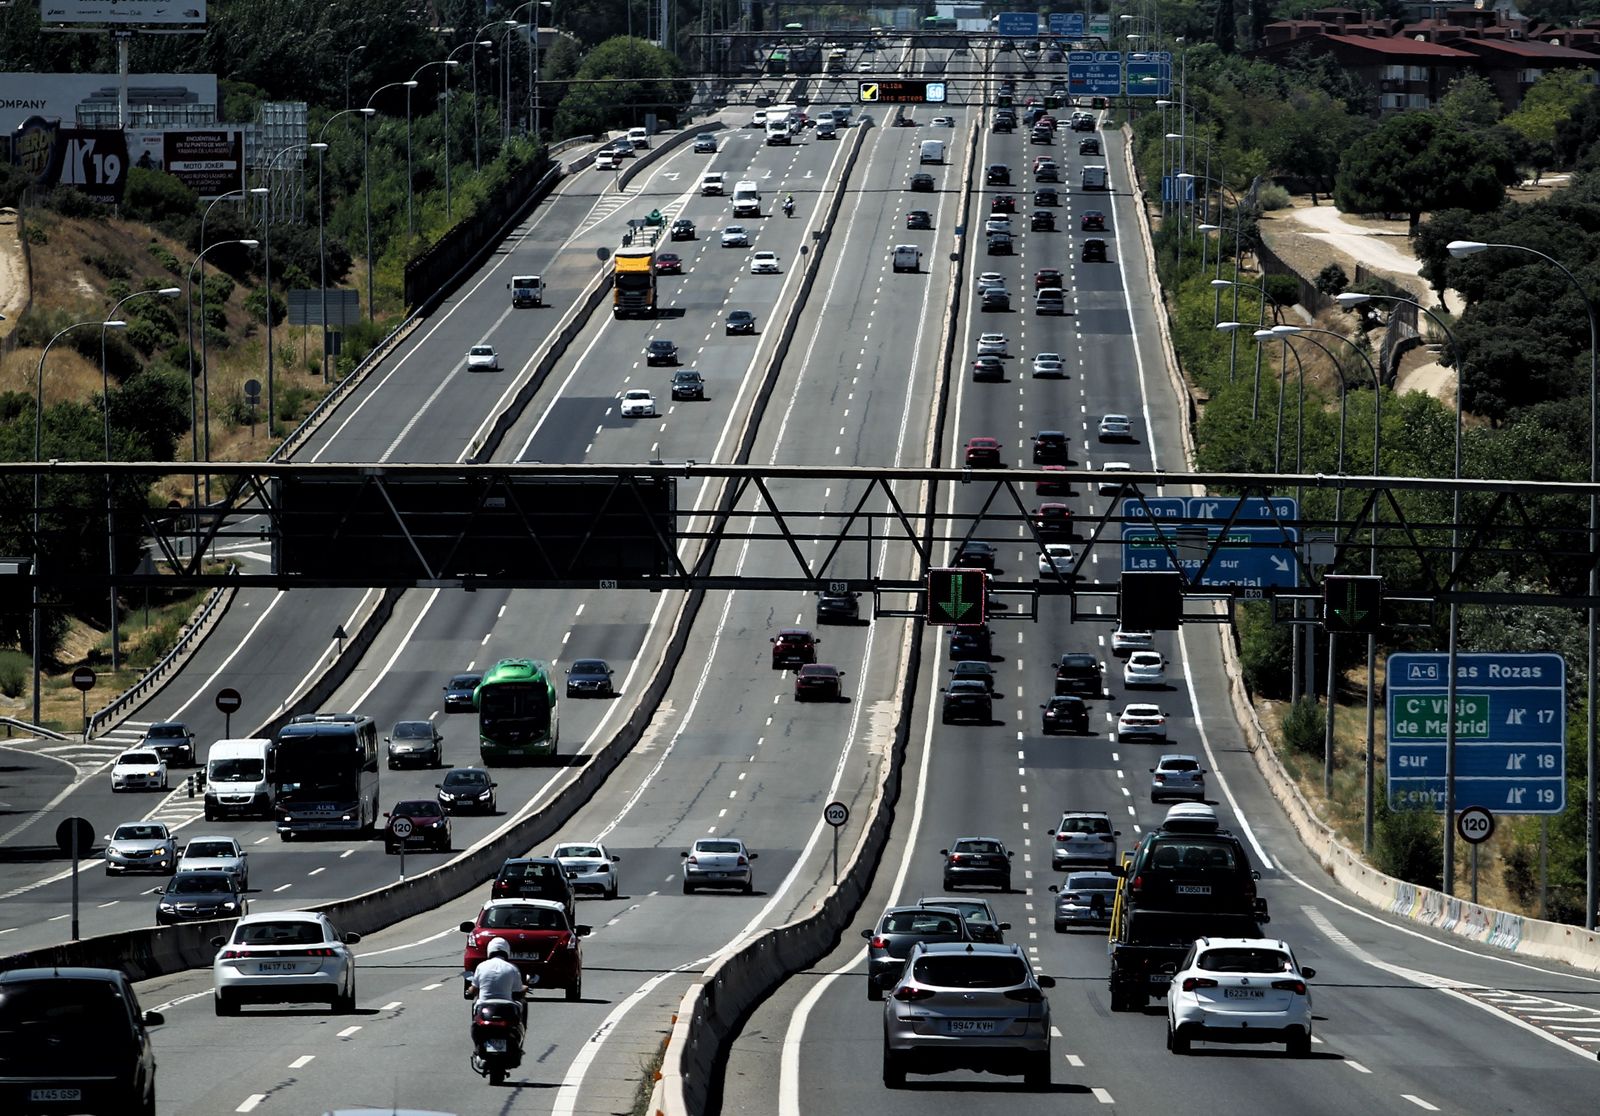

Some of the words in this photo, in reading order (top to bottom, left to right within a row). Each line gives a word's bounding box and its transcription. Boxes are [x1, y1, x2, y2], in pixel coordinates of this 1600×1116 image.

[929, 86, 941, 98] 60
[92, 153, 121, 184] 19
[1166, 508, 1177, 516] m
[1131, 556, 1157, 569] Las
[1166, 556, 1206, 569] Roza
[1219, 559, 1240, 569] sur
[1410, 665, 1437, 678] A-6
[1447, 664, 1479, 679] as
[1488, 664, 1543, 679] Rozas
[1537, 709, 1555, 724] 17
[1396, 719, 1419, 734] de
[1425, 719, 1487, 735] Madrid
[1398, 755, 1428, 768] sur
[1536, 753, 1556, 769] 18
[1399, 788, 1456, 803] centr
[1536, 788, 1556, 804] 19
[829, 810, 844, 819] 120
[394, 823, 411, 833] 120
[1463, 818, 1488, 832] 120
[953, 1021, 974, 1030] 9947
[976, 1020, 993, 1030] KVH
[33, 1089, 58, 1100] 4145
[60, 1089, 80, 1100] GSP
